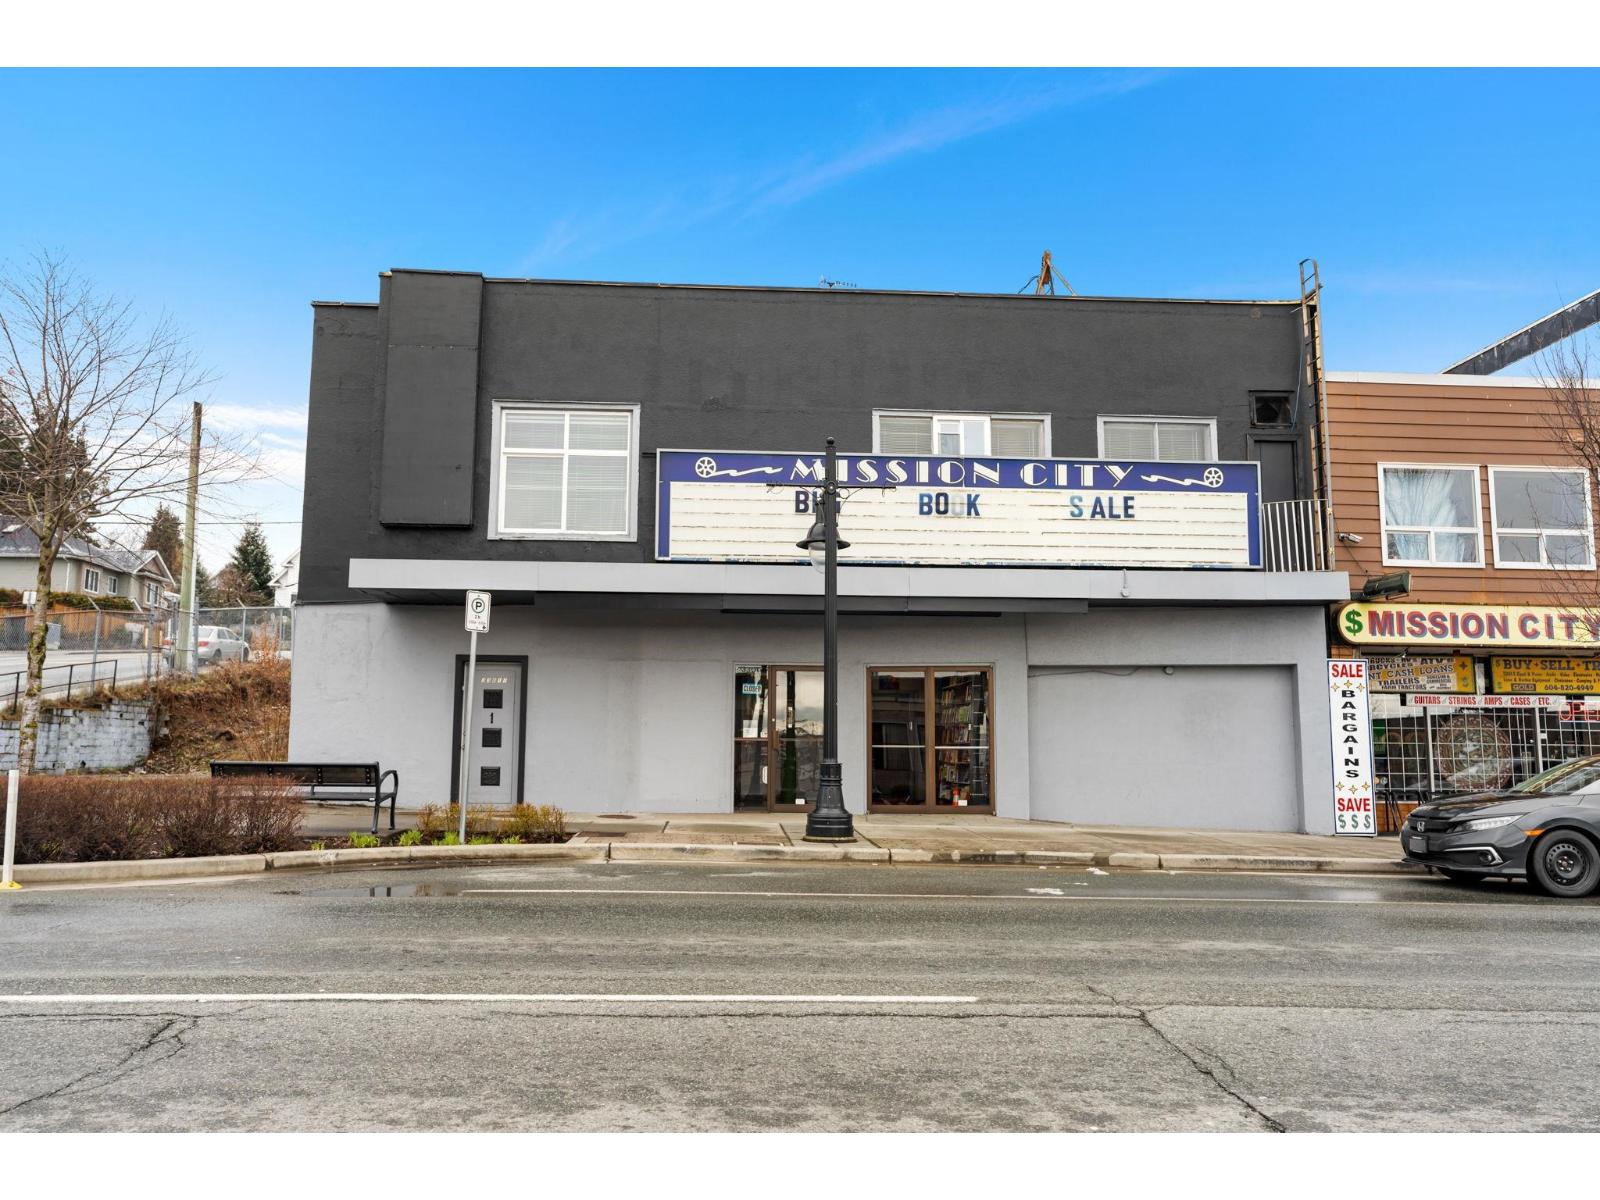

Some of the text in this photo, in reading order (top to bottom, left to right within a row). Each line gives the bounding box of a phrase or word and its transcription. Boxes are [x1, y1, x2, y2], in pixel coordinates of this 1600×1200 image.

[789, 458, 1134, 488] MISSION CITY
[919, 492, 981, 516] BOOK
[1069, 495, 1135, 519] SALE
[1368, 610, 1510, 640] MISSION
[1331, 664, 1364, 678] SALE
[1387, 668, 1414, 678] CASH
[1420, 664, 1454, 675] LOANS
[1503, 659, 1533, 670] BUY
[1540, 659, 1575, 671] SELL
[1582, 660, 1600, 671] TR
[1378, 677, 1420, 686] TRAILERS
[1414, 696, 1441, 705] GUITARS
[1448, 696, 1476, 705] STRINGS
[1484, 697, 1503, 705] AMPS
[1510, 697, 1531, 706] CASES
[1341, 690, 1359, 778] BARGAINS
[1337, 797, 1371, 812] SAVE
